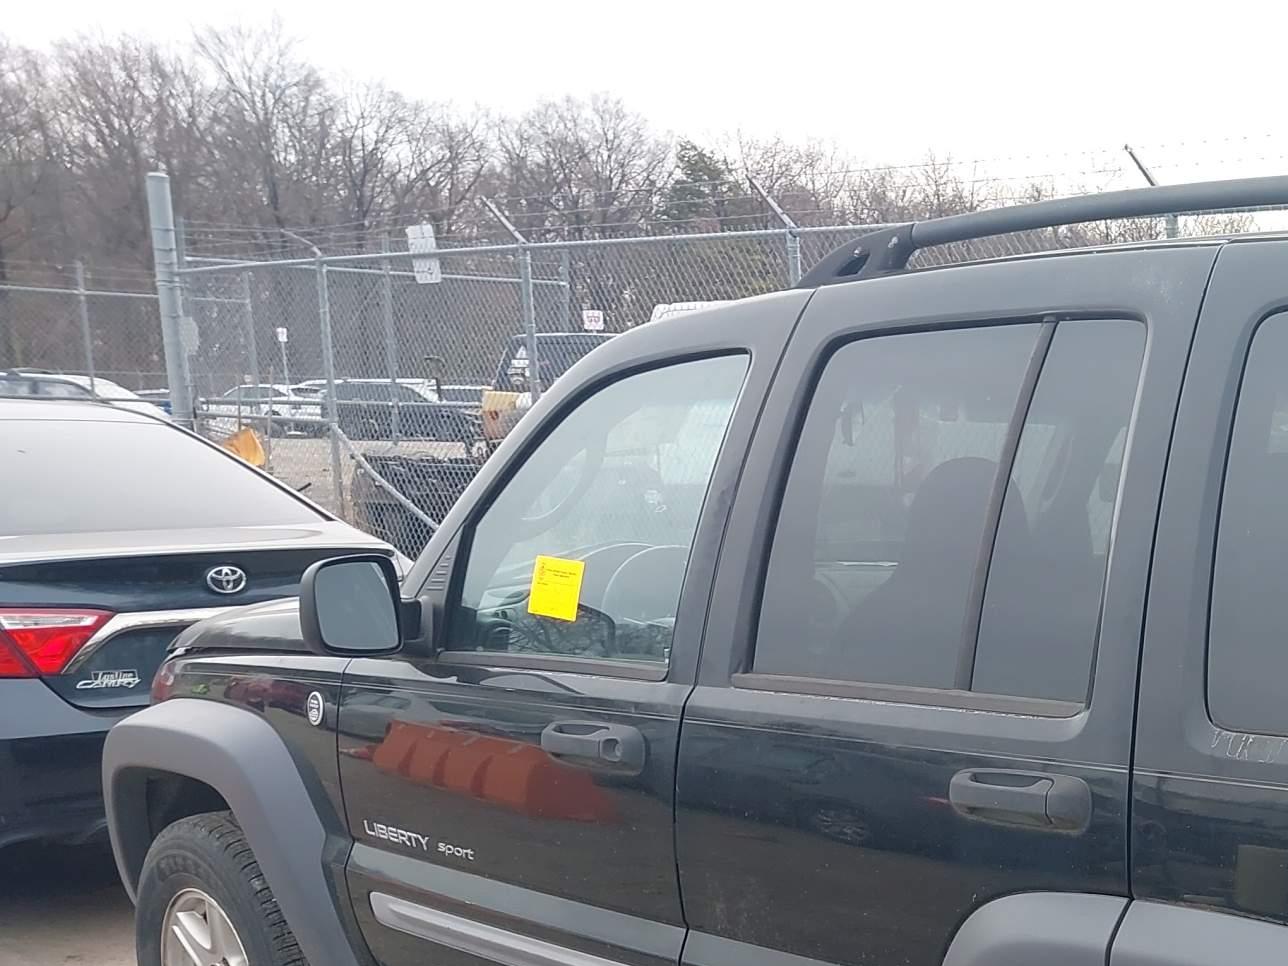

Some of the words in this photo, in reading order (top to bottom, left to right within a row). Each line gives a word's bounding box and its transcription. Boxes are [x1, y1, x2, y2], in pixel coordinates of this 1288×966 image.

[76, 678, 142, 689] CAMRY
[363, 819, 430, 851] LIBERTY
[437, 842, 475, 860] sport
